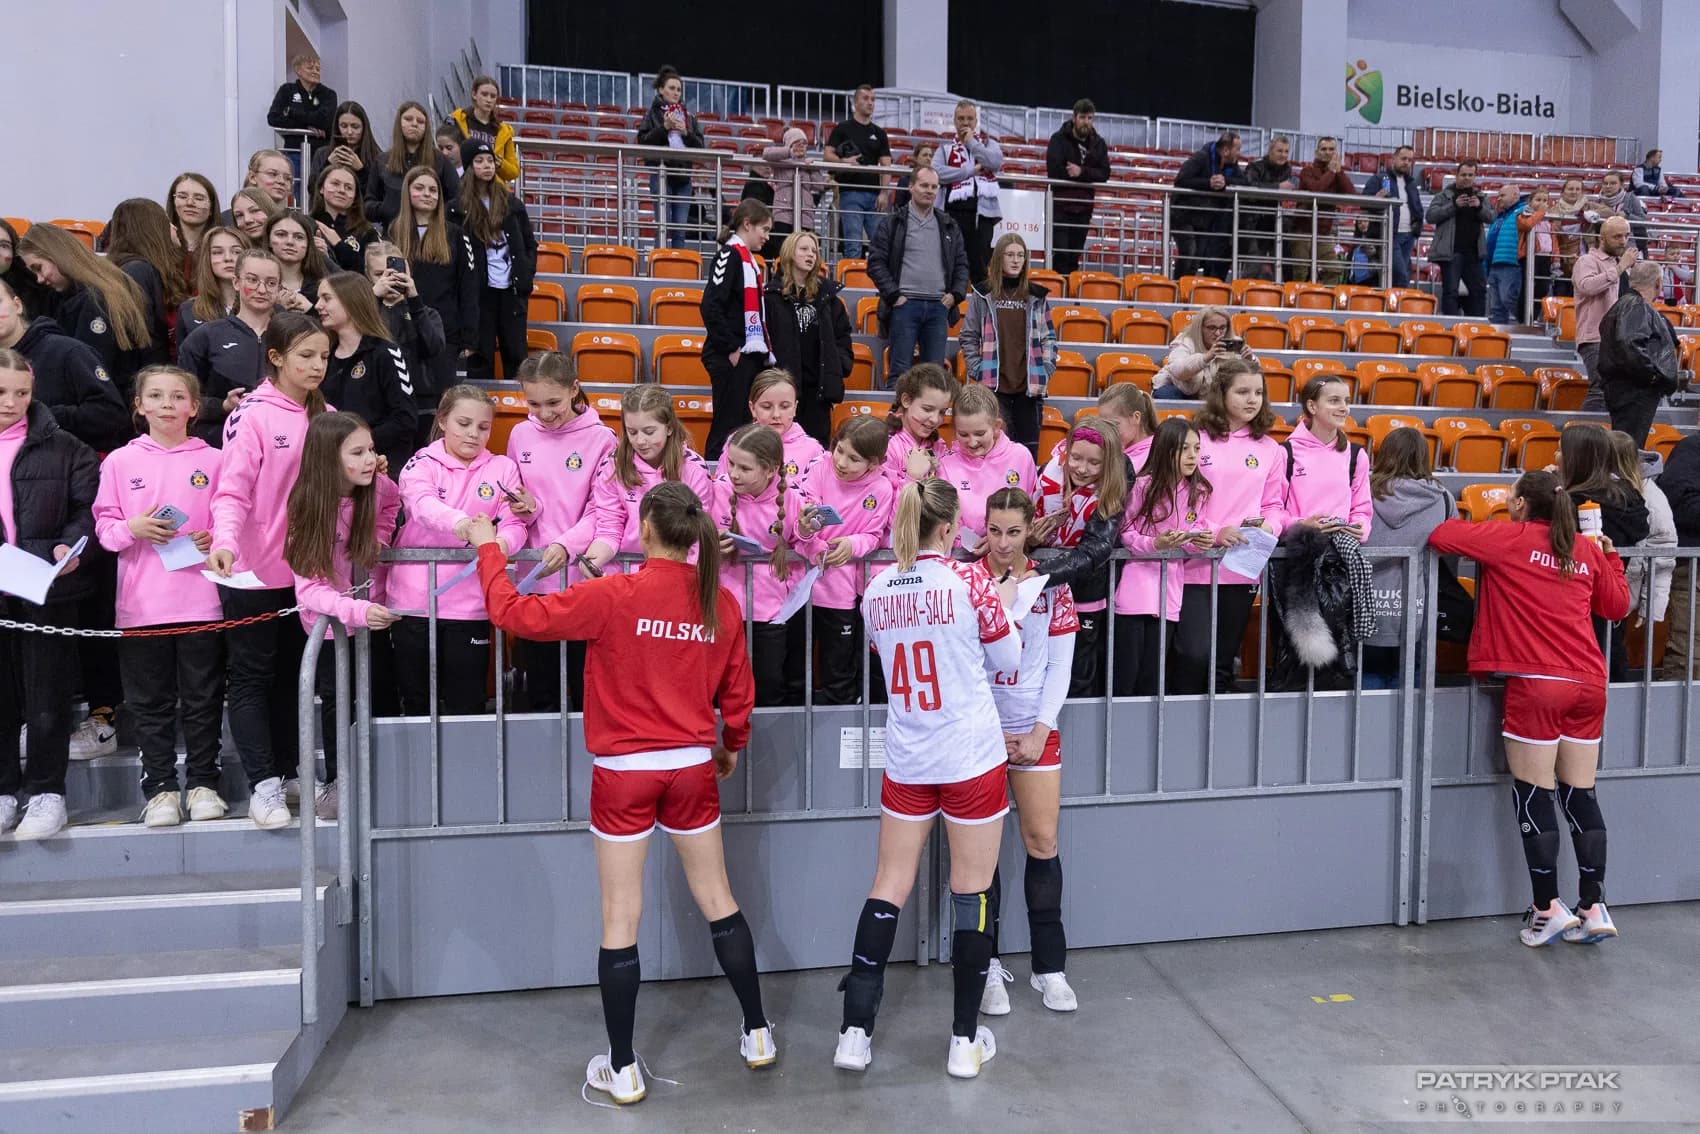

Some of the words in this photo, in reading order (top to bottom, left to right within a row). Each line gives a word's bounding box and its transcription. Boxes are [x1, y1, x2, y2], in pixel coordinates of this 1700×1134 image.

[1396, 84, 1556, 118] Bielsko-Biała
[1006, 222, 1019, 231] DO
[891, 640, 942, 712] 49
